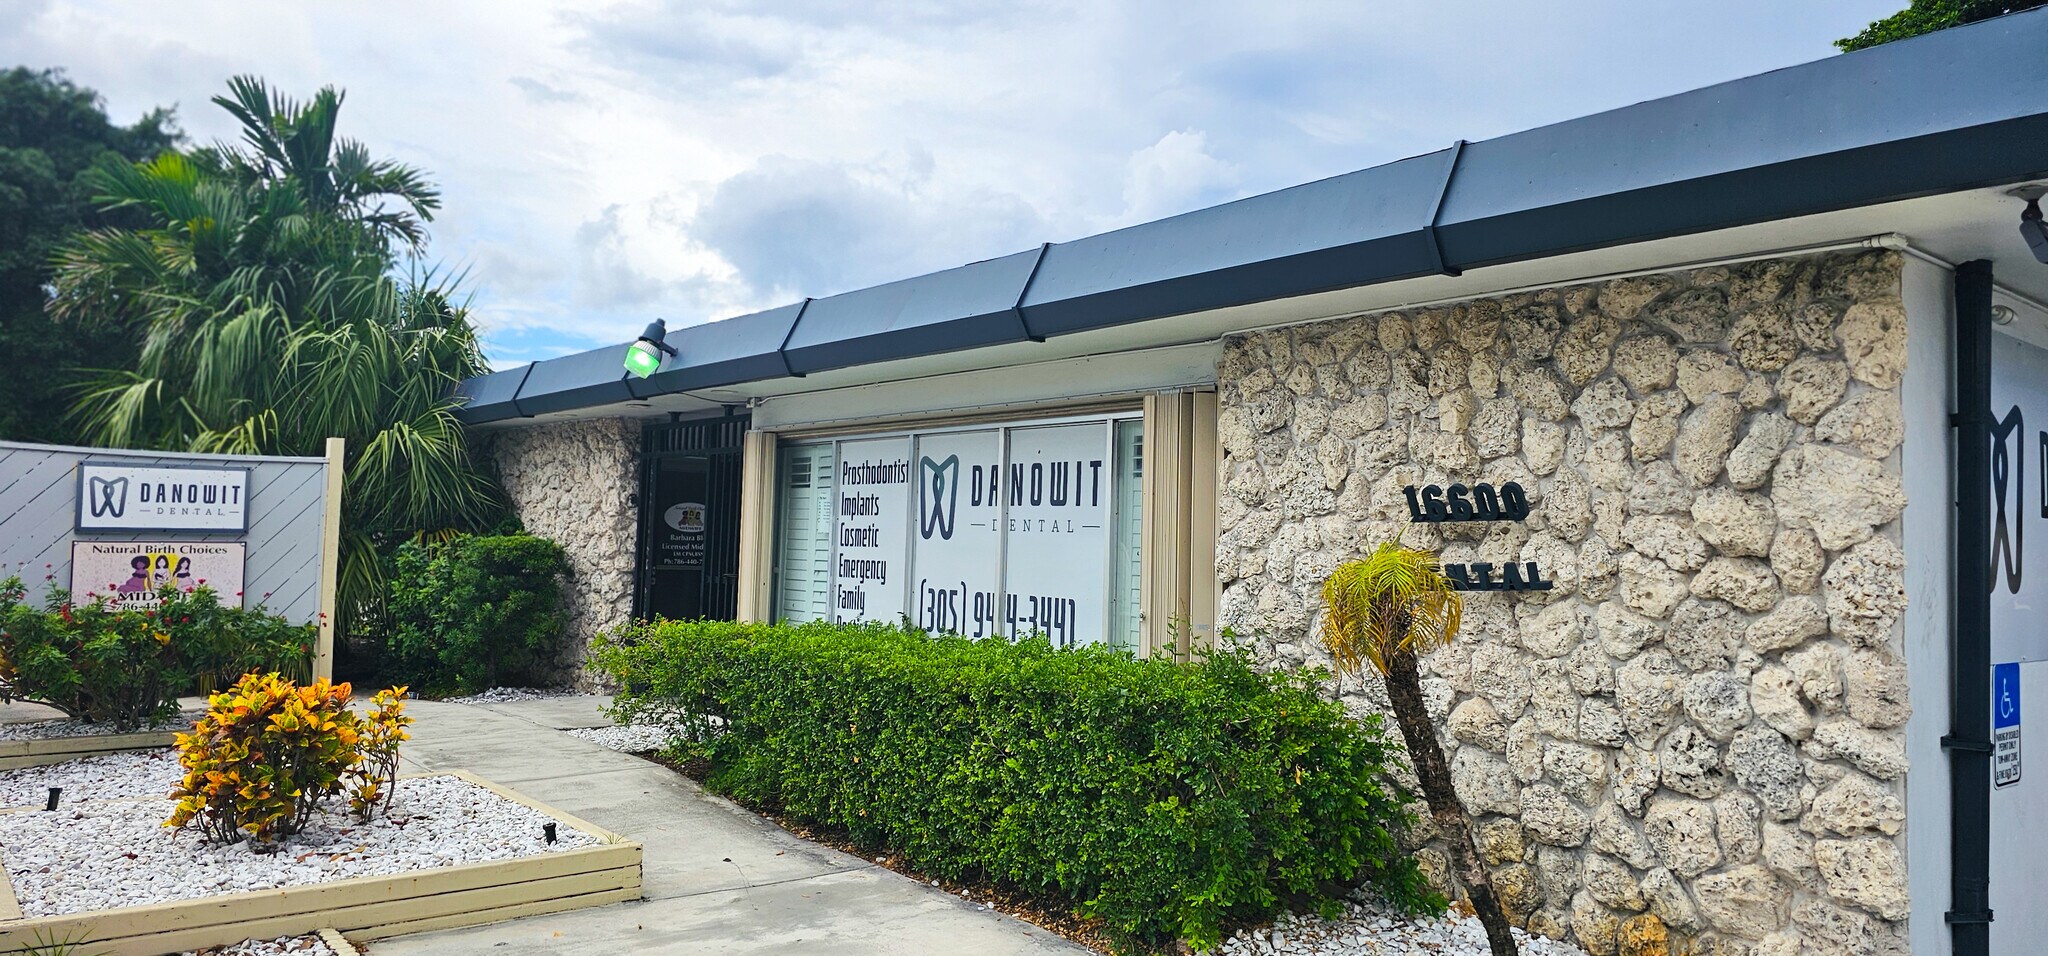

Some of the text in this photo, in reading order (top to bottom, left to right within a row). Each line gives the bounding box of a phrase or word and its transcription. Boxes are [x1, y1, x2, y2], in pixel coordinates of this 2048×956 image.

[842, 459, 909, 486] Prosthodontist
[971, 460, 1102, 507] DANOWIT
[140, 483, 241, 504] DANOWIT
[841, 491, 879, 520] Implants
[1402, 481, 1530, 522] 16600
[157, 507, 224, 516] DENTAL
[92, 545, 228, 554] Natural Birth Choices
[840, 522, 879, 548] Cosmetic
[839, 553, 887, 585] Emergency
[1433, 562, 1554, 592] NTAL
[115, 602, 162, 611] 786-44
[837, 584, 866, 615] Family
[919, 578, 967, 636] (305)
